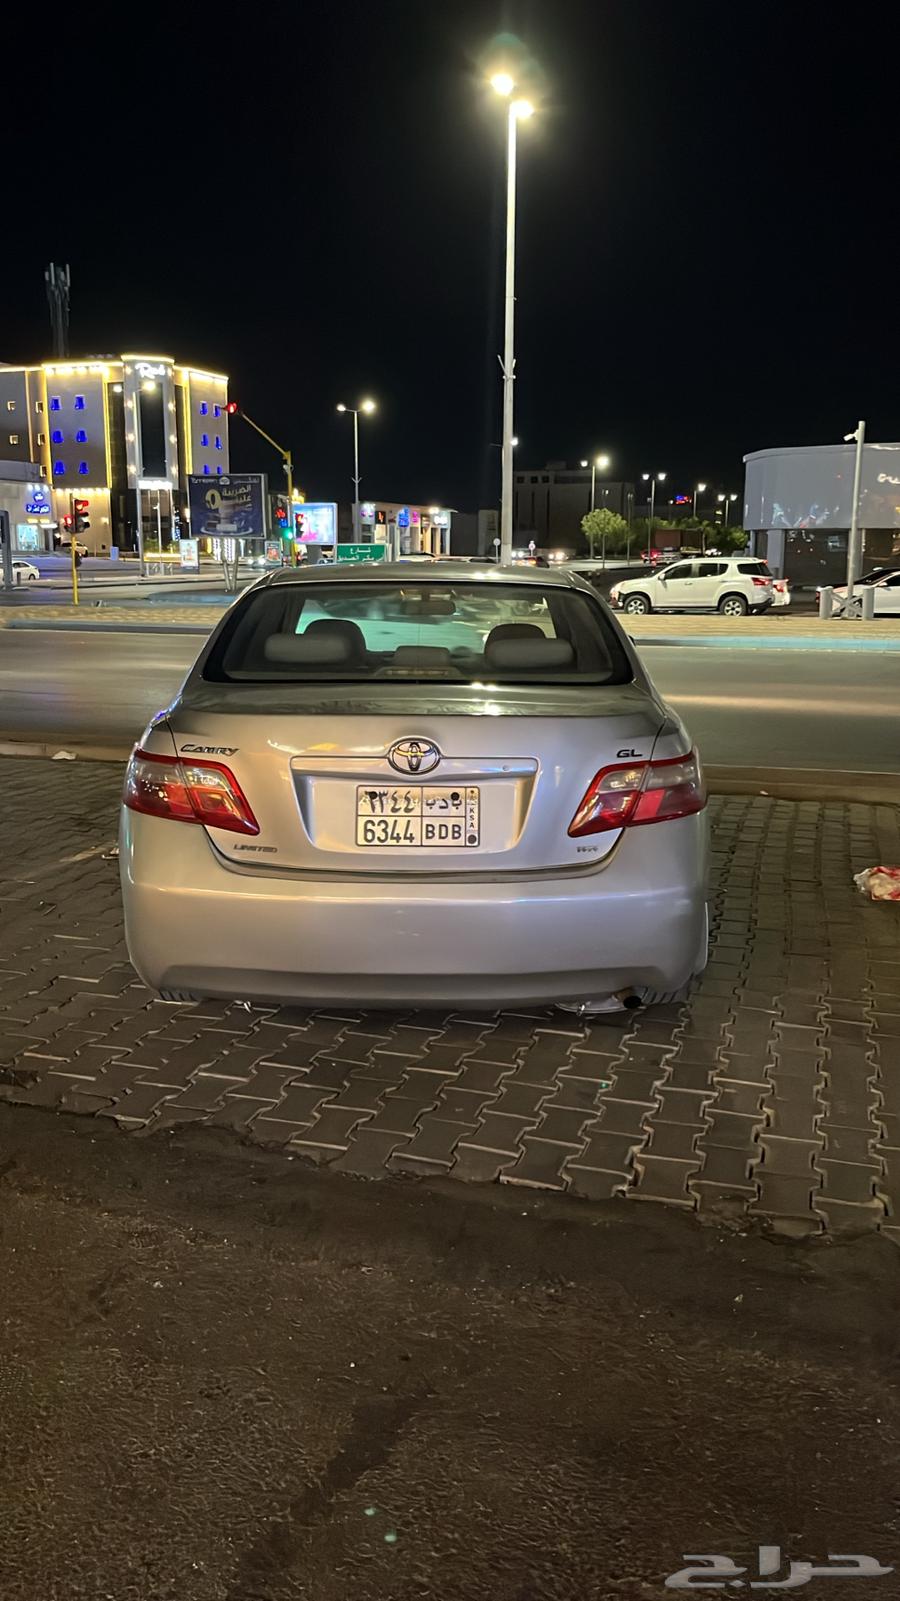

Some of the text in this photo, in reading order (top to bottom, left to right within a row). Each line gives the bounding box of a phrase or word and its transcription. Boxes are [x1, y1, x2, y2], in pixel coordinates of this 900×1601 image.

[350, 547, 371, 555] شارع
[616, 749, 643, 758] GL
[363, 819, 462, 843] 6344 BDB
